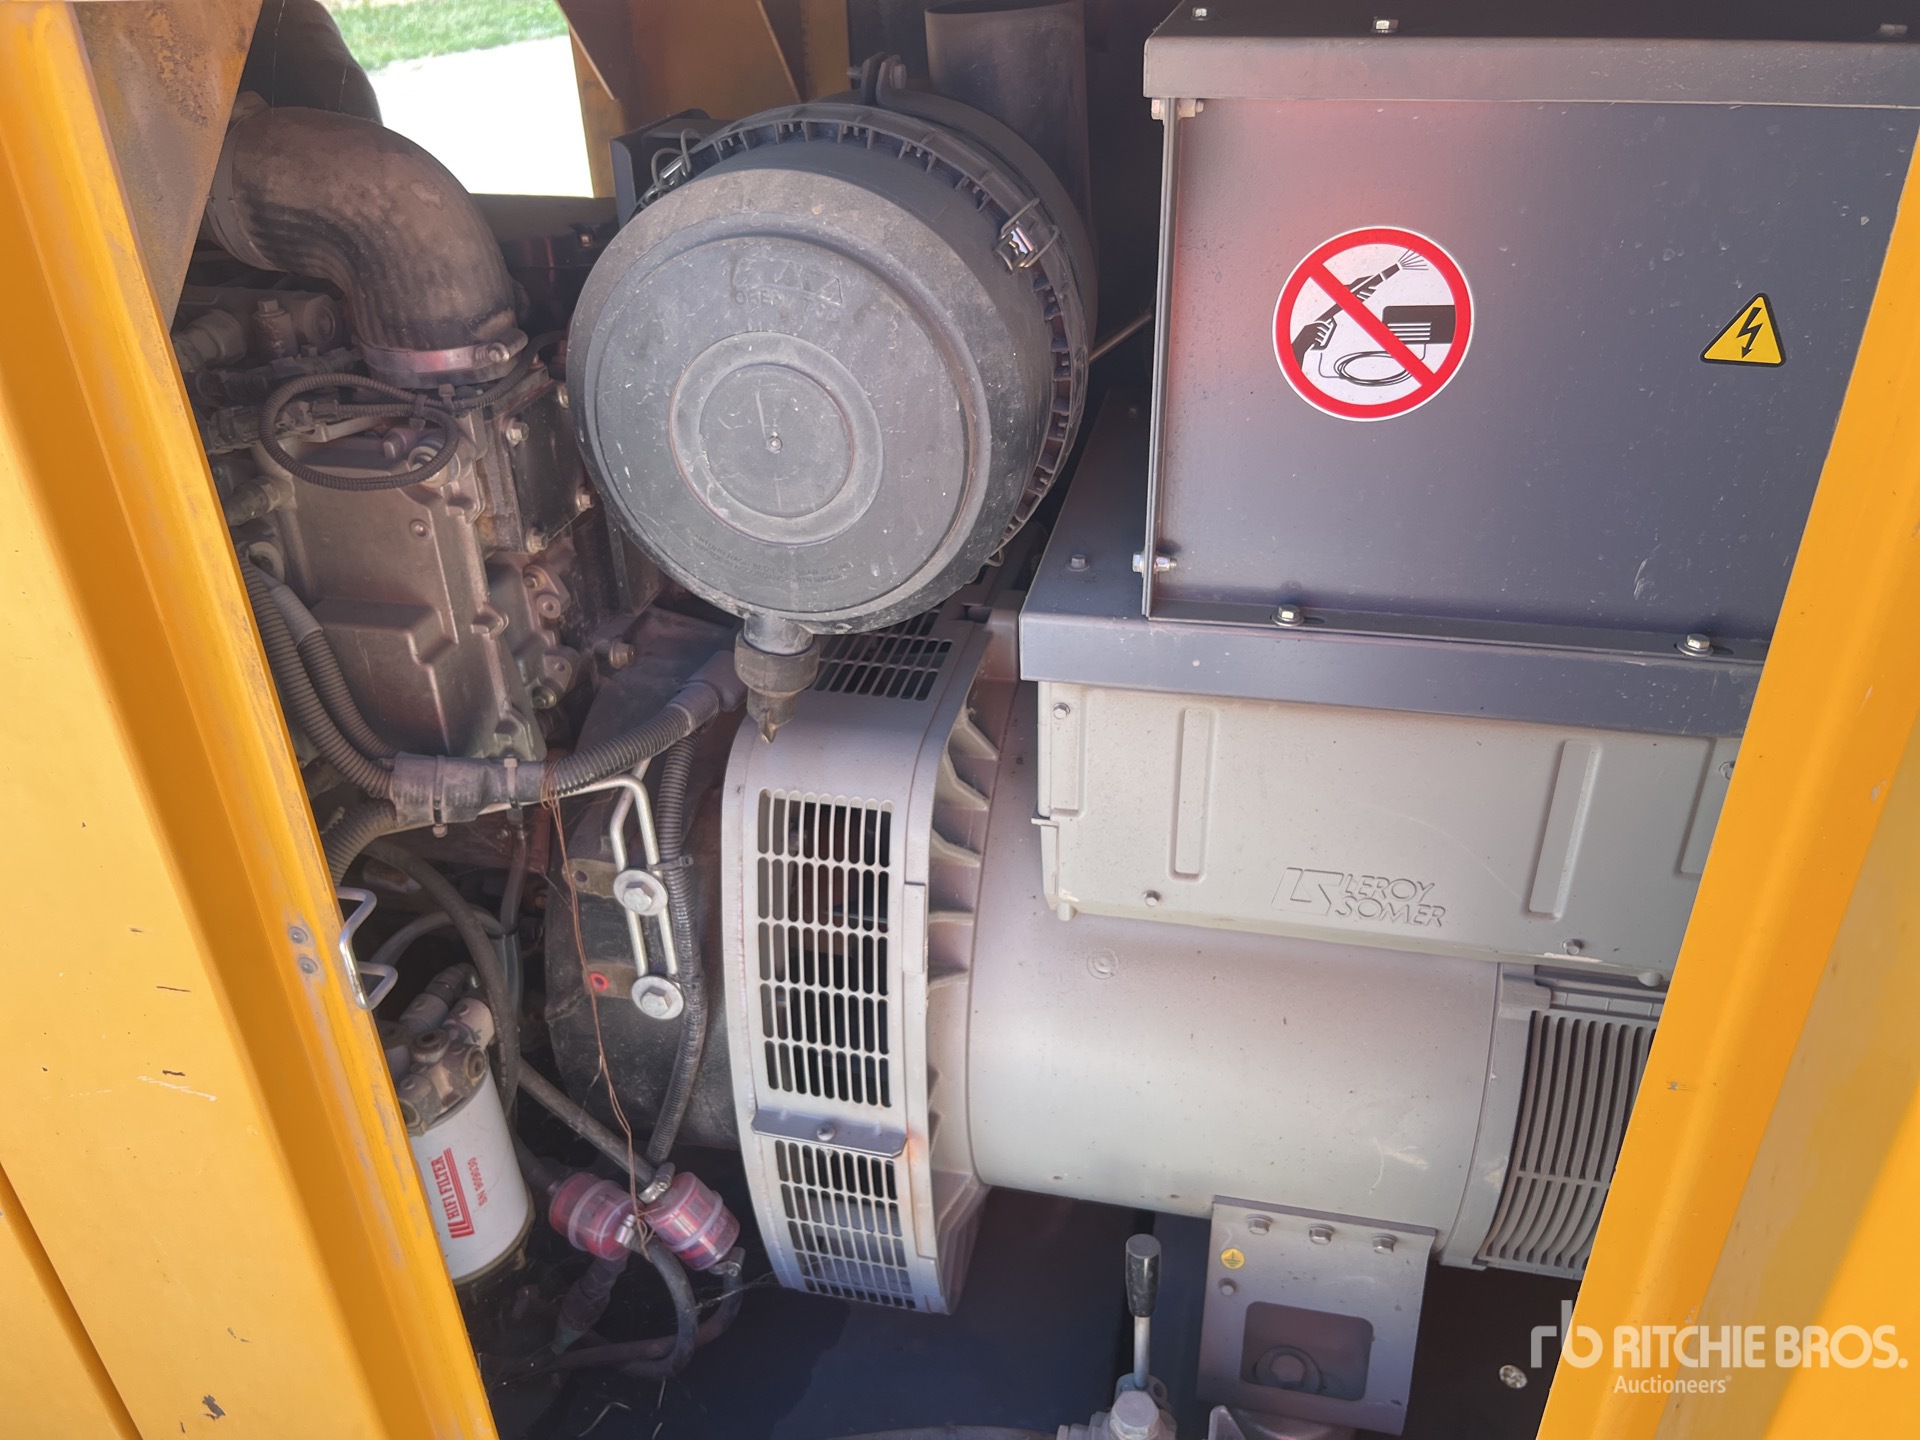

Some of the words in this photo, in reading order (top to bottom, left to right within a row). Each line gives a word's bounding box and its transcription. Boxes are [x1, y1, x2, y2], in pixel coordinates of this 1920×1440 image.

[1341, 873, 1435, 903] LEROY
[1335, 895, 1447, 927] SOMER
[431, 1155, 453, 1195] FILTER
[442, 1194, 460, 1220] HIFI
